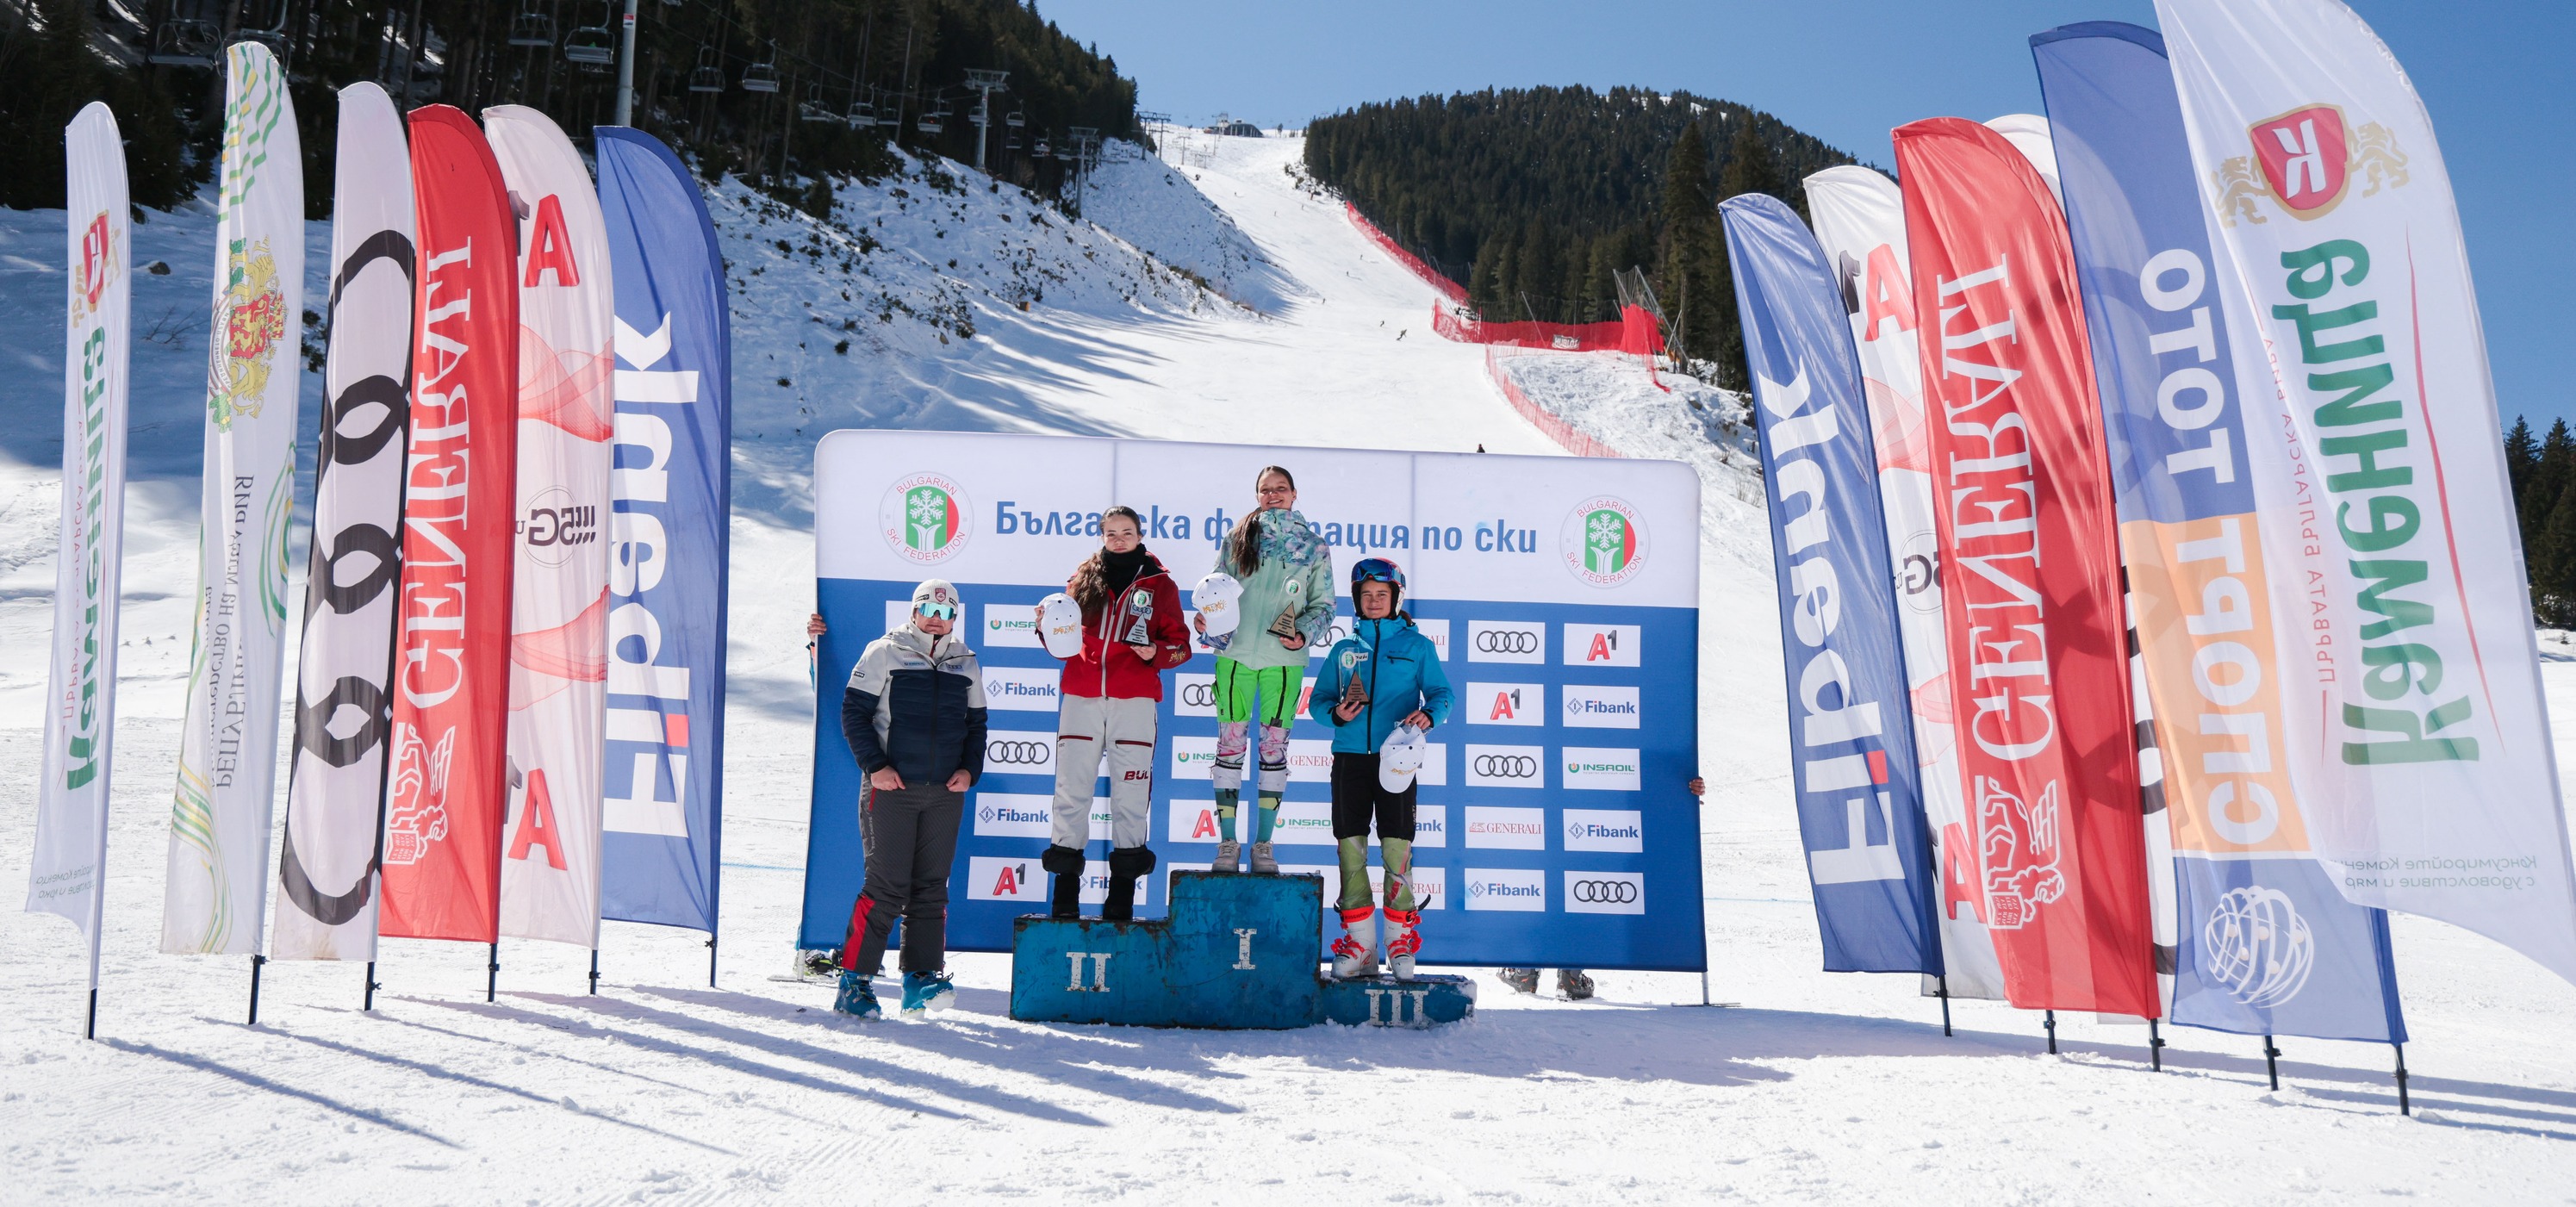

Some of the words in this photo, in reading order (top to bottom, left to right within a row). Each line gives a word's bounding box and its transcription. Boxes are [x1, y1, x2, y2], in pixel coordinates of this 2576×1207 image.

[896, 476, 958, 495] BULGARIAN
[1577, 500, 1634, 520] BULGARIAN
[996, 501, 1191, 540] Бългаска
[1422, 525, 1462, 551] по
[1475, 520, 1536, 553] ски
[887, 528, 902, 546] SKI
[903, 531, 966, 561] FEDERATION
[1566, 551, 1581, 569] SKI
[1582, 555, 1642, 584] FEDERATION
[1586, 630, 1617, 662] A1
[1005, 681, 1056, 696] Fibank
[1490, 687, 1521, 720] A1
[1584, 700, 1636, 714] Fibank
[1290, 755, 1335, 766] GENERA
[997, 808, 1049, 823] Fibank
[1486, 823, 1541, 835] GENERALI
[1587, 824, 1640, 838] Fibank
[992, 863, 1026, 896] A1
[1488, 883, 1540, 897] Fibank
[1233, 928, 1258, 971] I
[1066, 951, 1111, 992] II
[1364, 988, 1428, 1027] III
